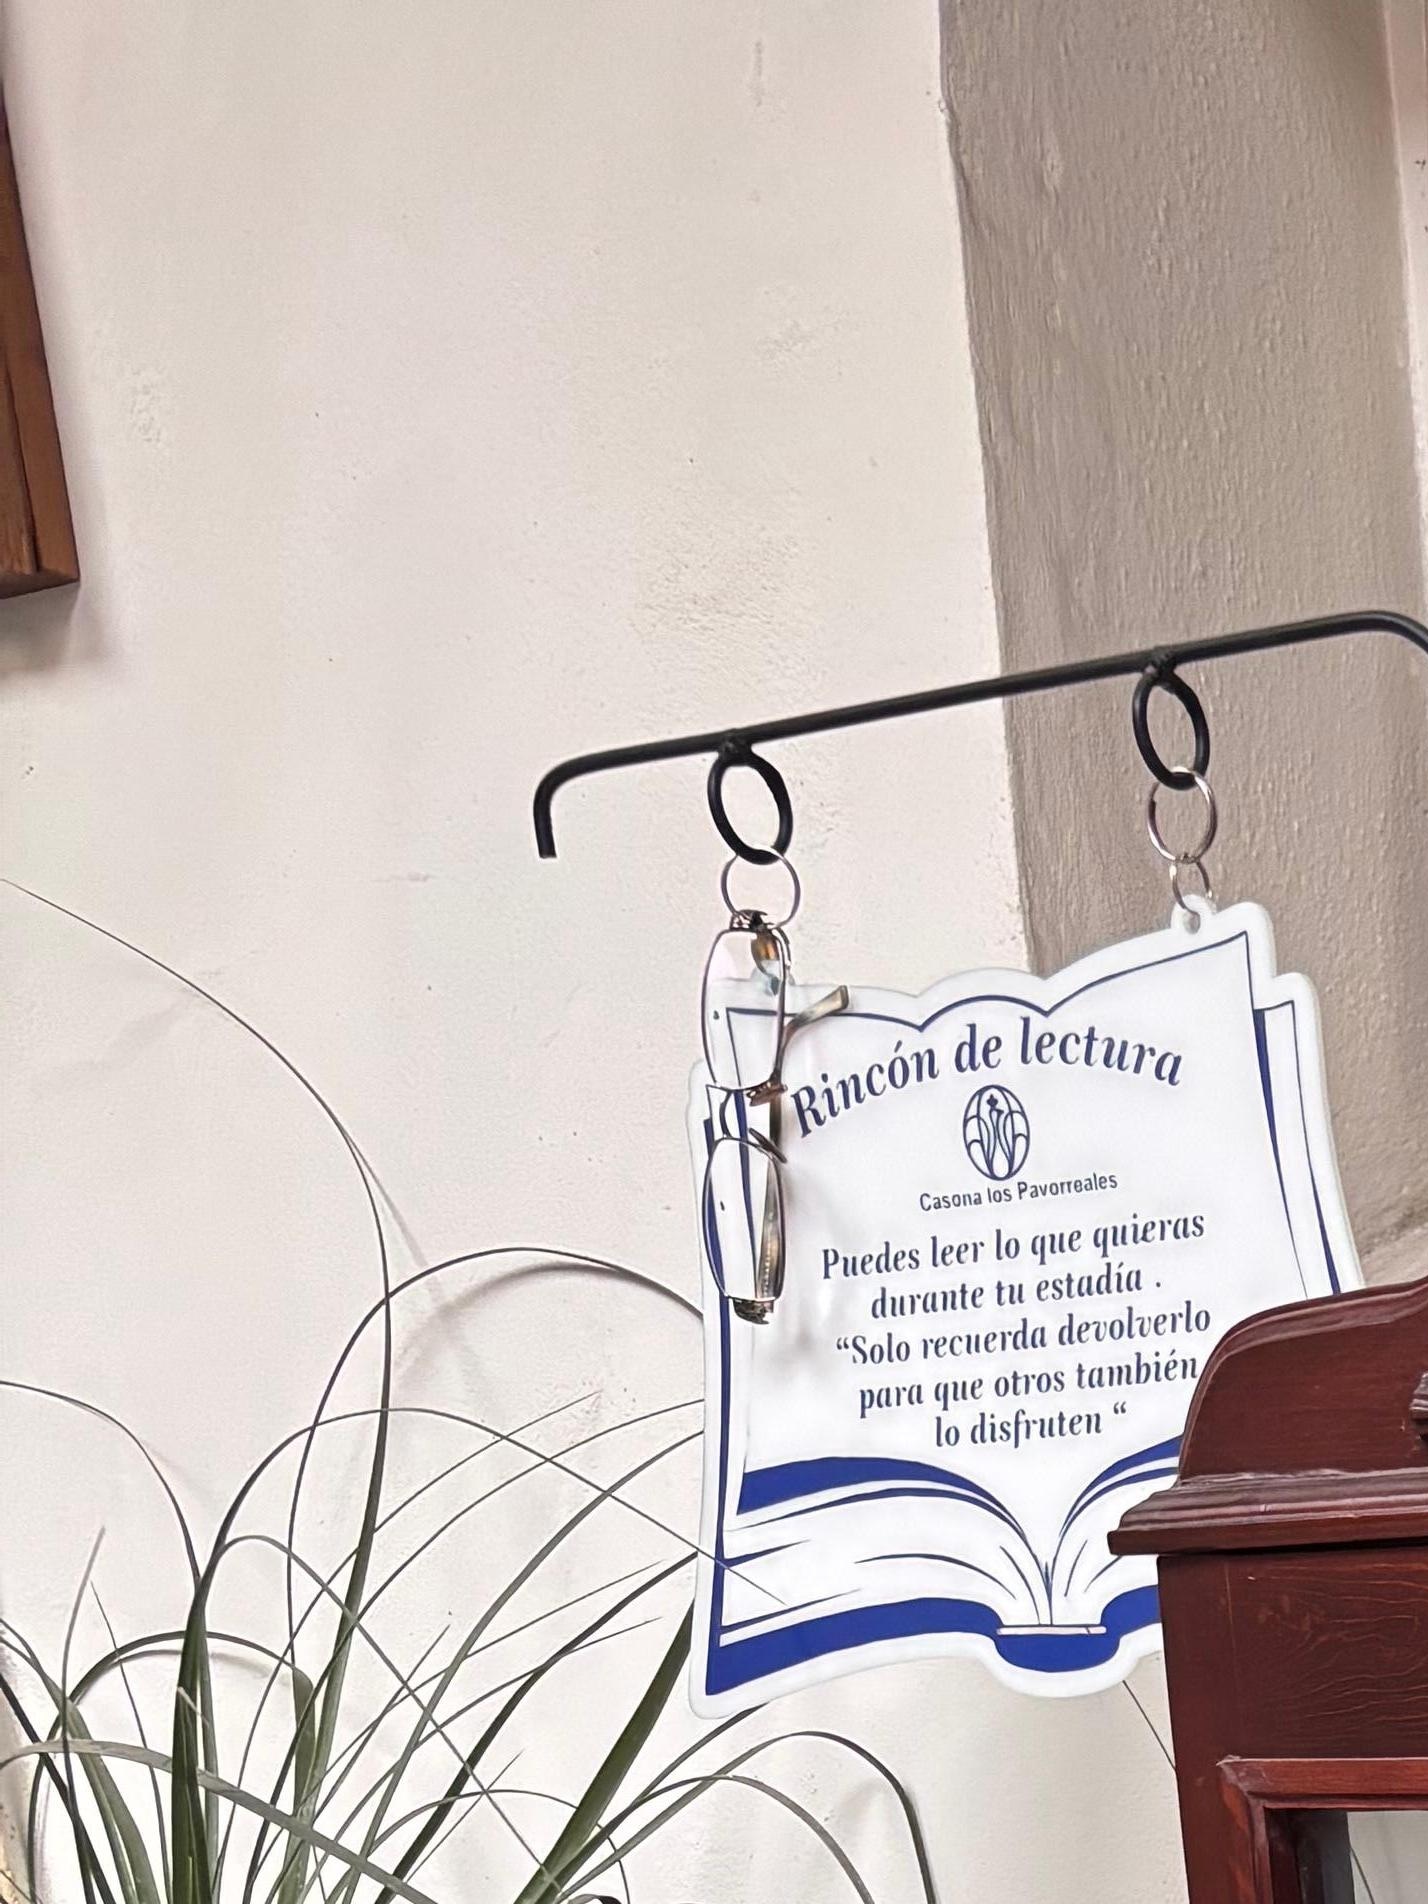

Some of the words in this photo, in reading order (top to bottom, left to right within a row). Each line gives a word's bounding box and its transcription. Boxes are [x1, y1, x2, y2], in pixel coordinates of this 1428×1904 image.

[791, 1040, 939, 1138] Rincón
[954, 1023, 1002, 1072] de
[1020, 1016, 1182, 1086] lectura
[919, 1190, 982, 1211] Casona
[987, 1187, 1013, 1203] los
[1017, 1172, 1118, 1200] Pavorreales
[822, 1241, 920, 1280] Puedes
[930, 1236, 985, 1267] leer
[995, 1228, 1020, 1261] lo
[1031, 1228, 1082, 1265] que
[1093, 1213, 1204, 1257] quieras
[870, 1285, 984, 1319] durante
[996, 1279, 1025, 1304] tu
[1036, 1262, 1142, 1301] estadía
[921, 1318, 1047, 1361] recuerda
[1057, 1300, 1211, 1348] devolverlo
[859, 1382, 923, 1418] para
[934, 1376, 984, 1412] que
[994, 1369, 1066, 1399] otros
[1077, 1349, 1199, 1388] también
[935, 1416, 960, 1448] lo
[970, 1410, 1102, 1449] disfruten
